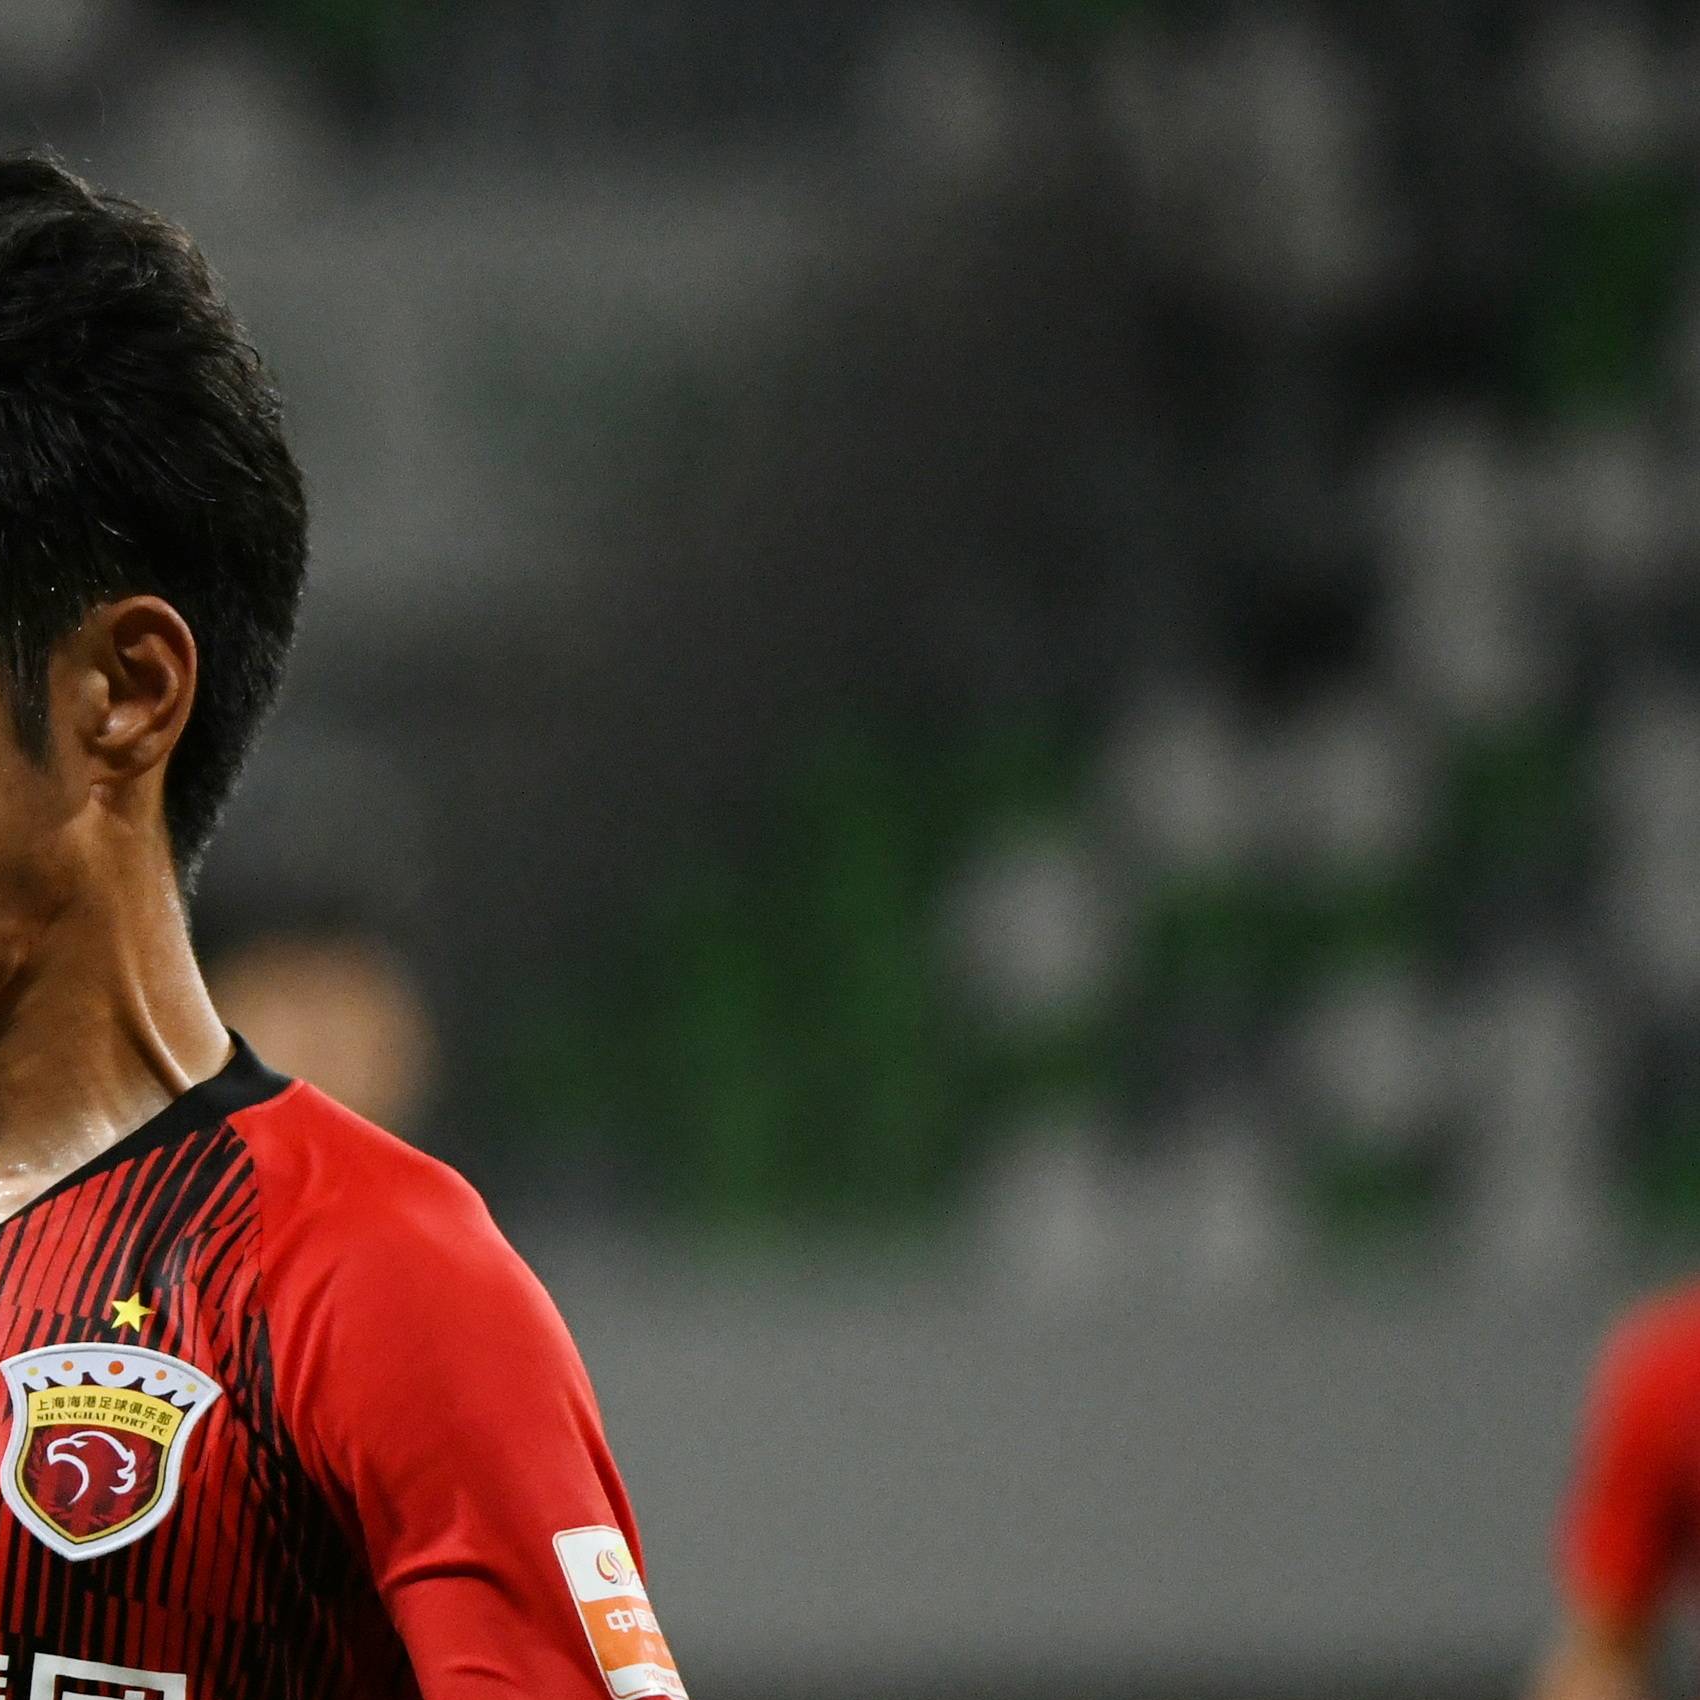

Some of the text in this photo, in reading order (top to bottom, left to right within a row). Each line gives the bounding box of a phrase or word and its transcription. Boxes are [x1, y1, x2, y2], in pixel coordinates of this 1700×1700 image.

[36, 1396, 173, 1426] 上海海港足球俱乐部
[37, 1411, 168, 1437] SHANGHAI PORT FC
